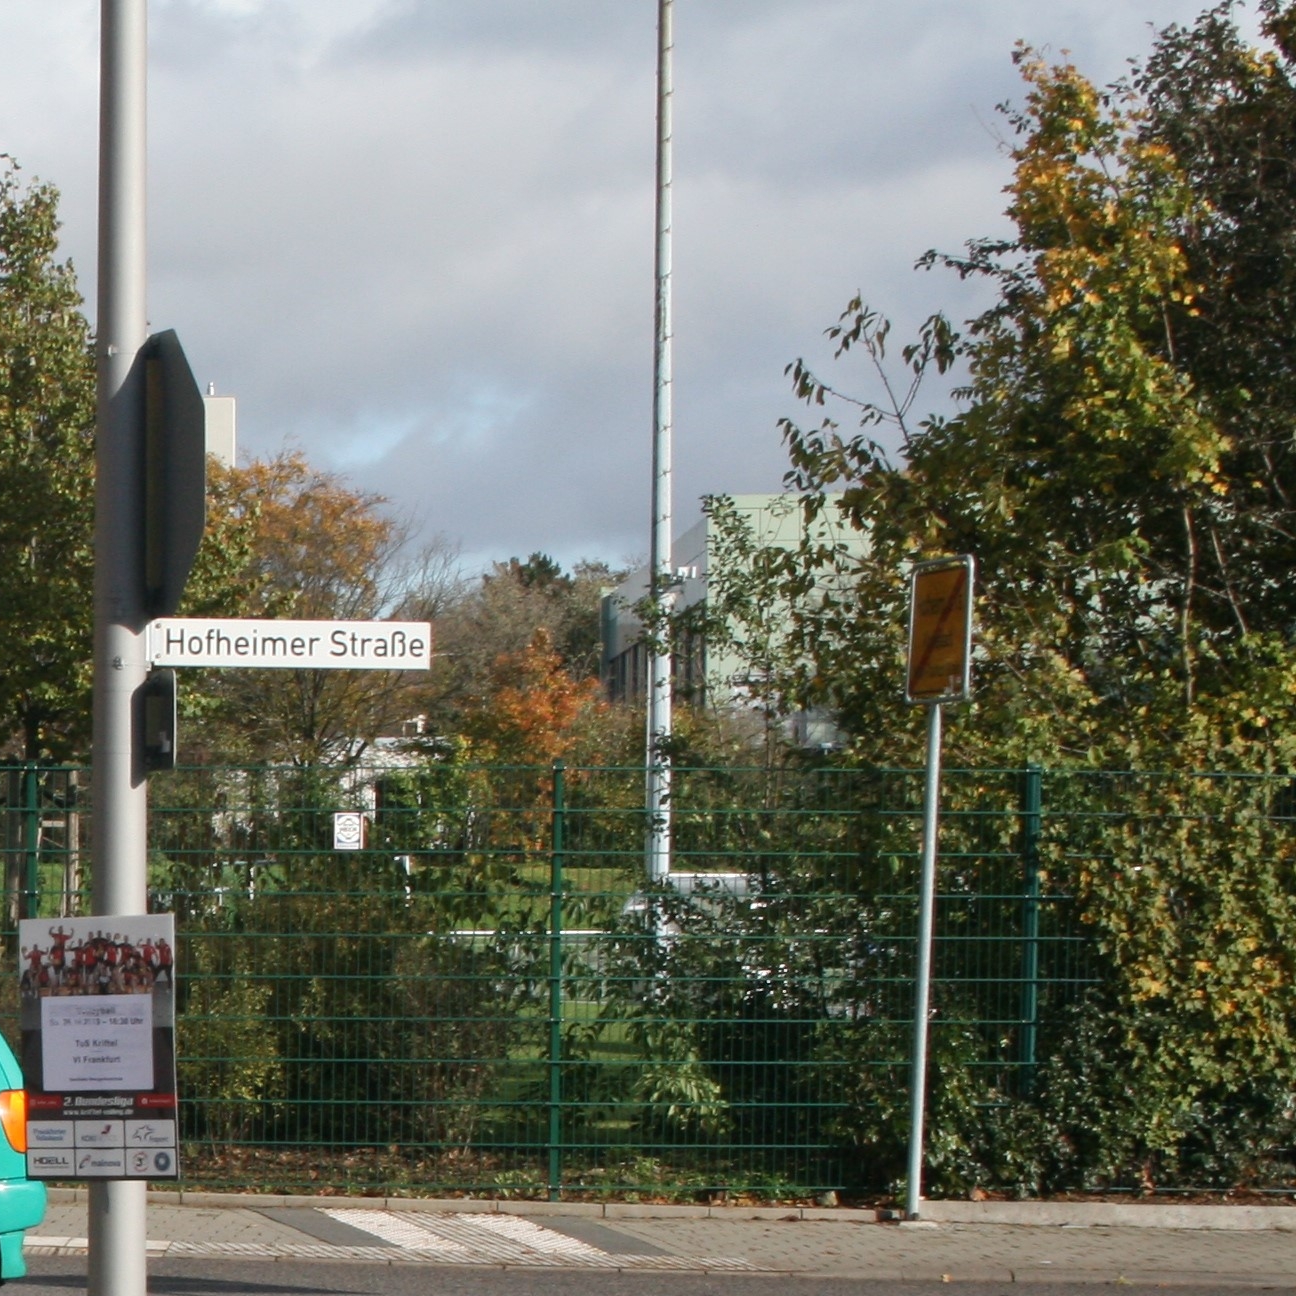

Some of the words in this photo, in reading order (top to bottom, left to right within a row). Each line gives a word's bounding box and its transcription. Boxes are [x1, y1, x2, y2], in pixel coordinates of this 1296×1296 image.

[165, 628, 320, 656] Hofheimer
[330, 630, 424, 657] Straße
[75, 1096, 134, 1108] Bundesliga
